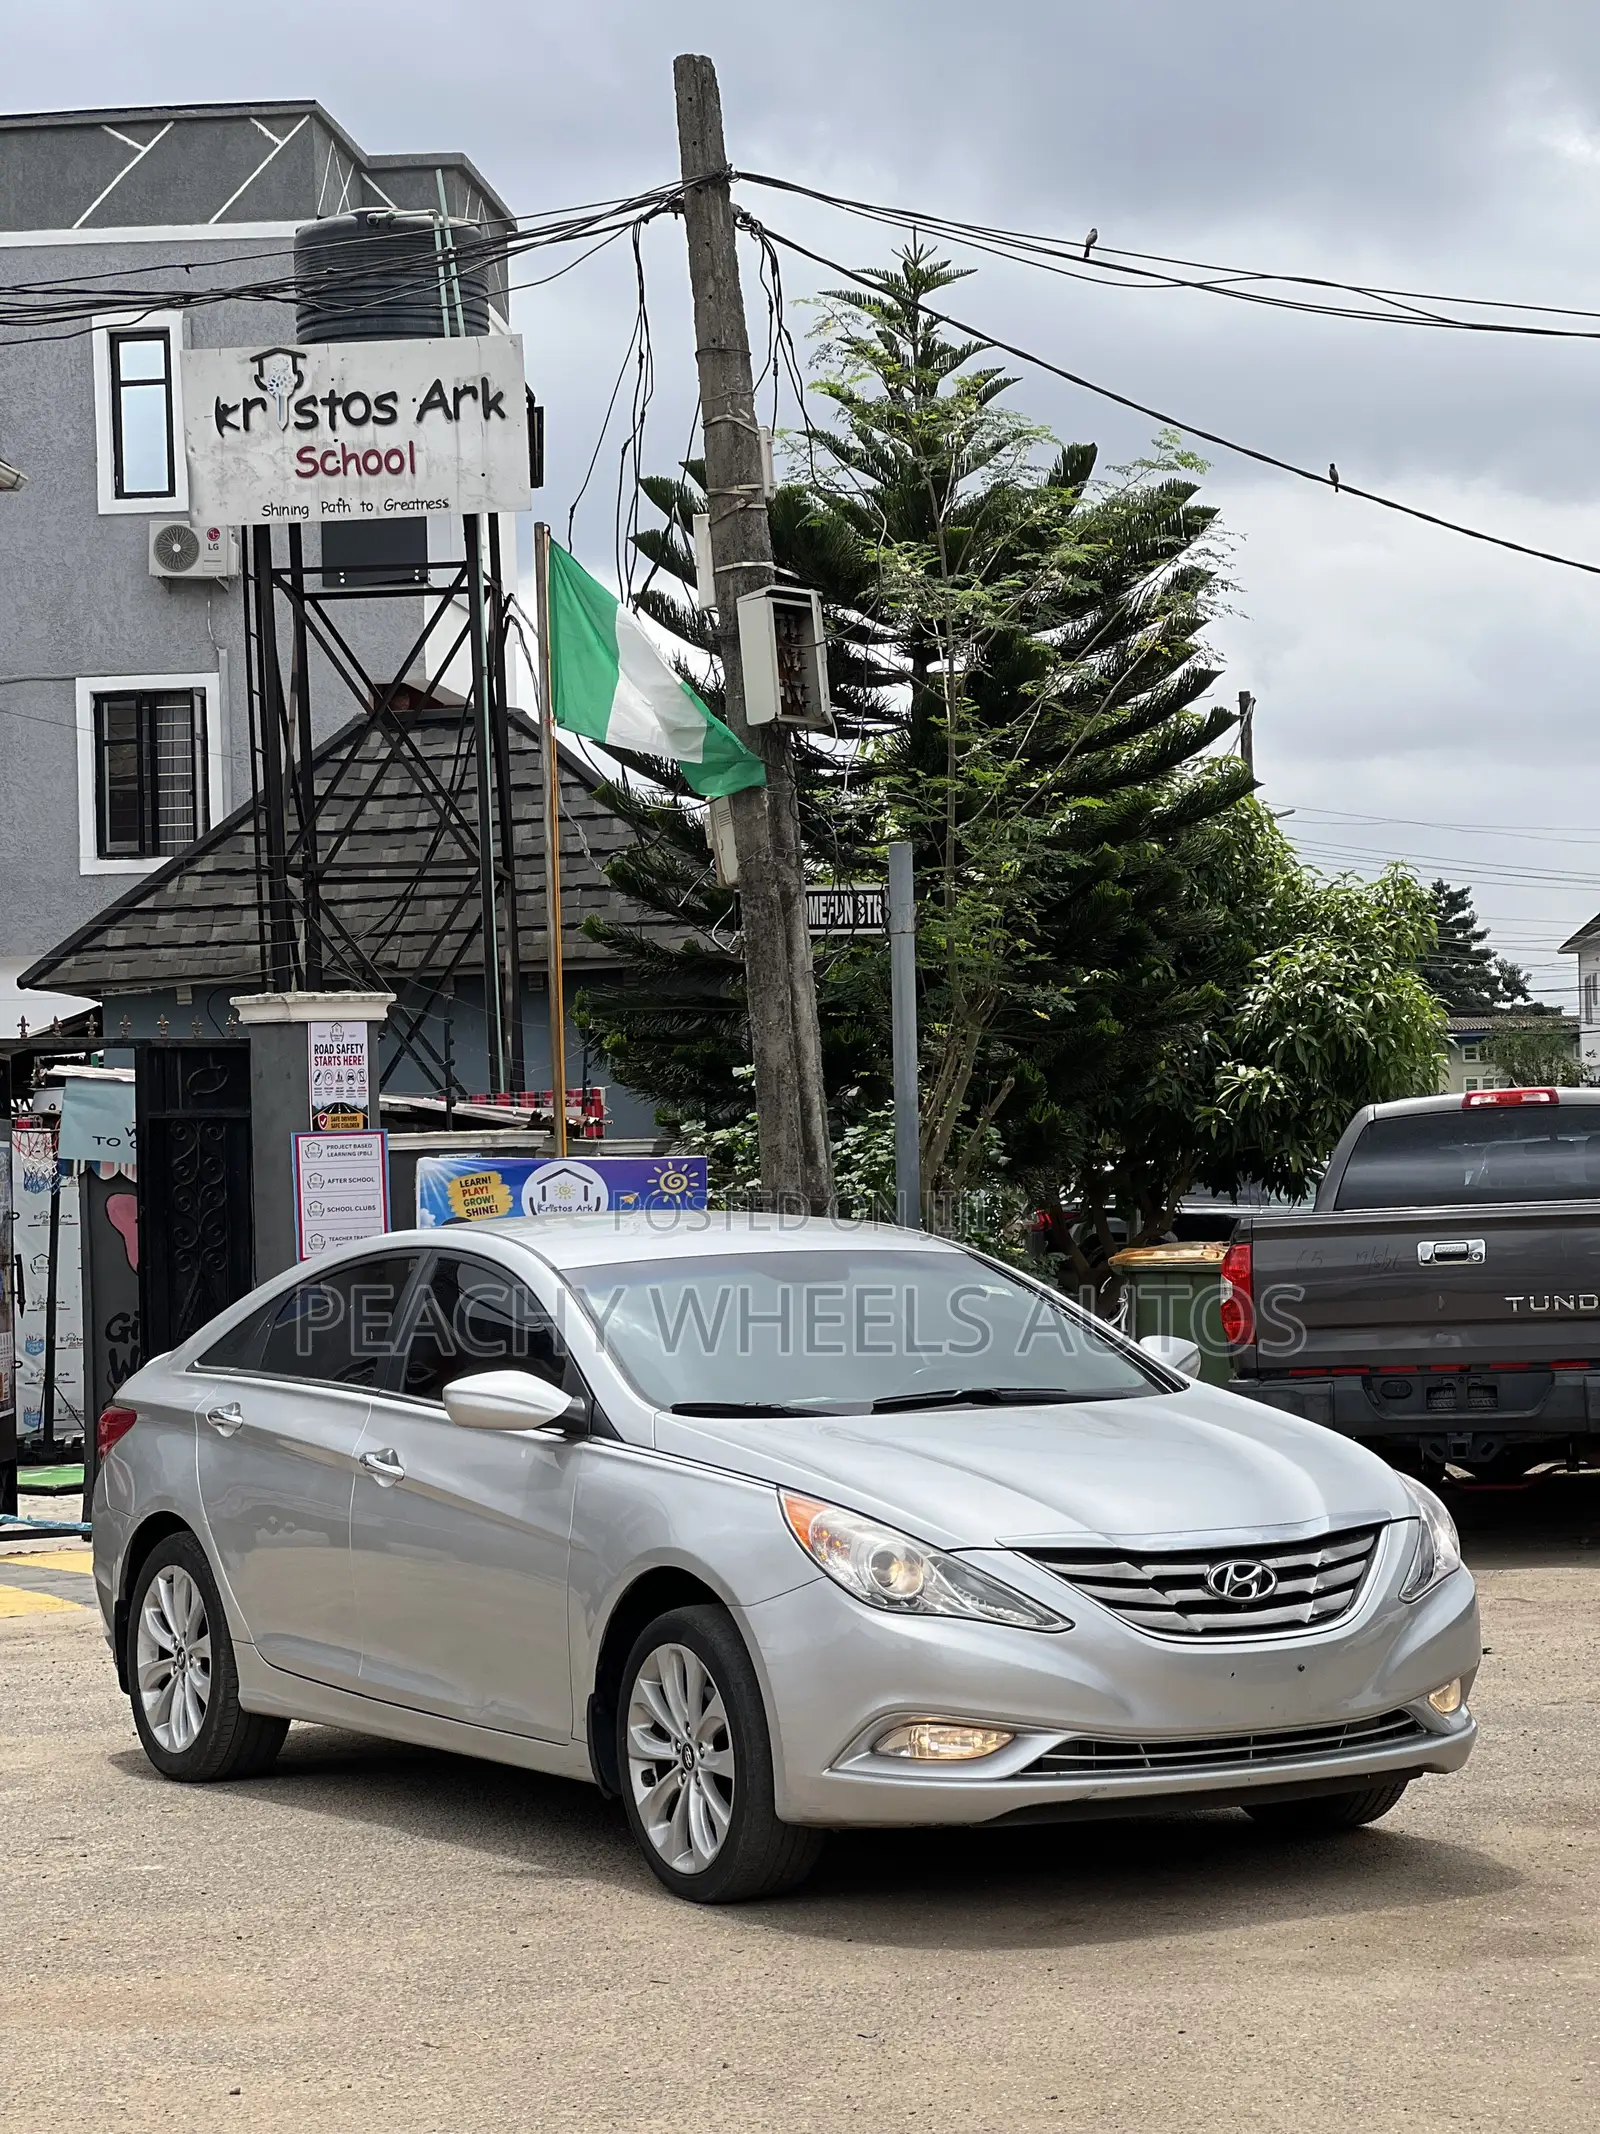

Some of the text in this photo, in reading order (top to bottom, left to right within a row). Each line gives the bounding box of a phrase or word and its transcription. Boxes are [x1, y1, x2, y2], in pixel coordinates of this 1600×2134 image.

[416, 377, 506, 423] Ark
[294, 440, 416, 479] School
[261, 498, 449, 519] Shining Path to Greatness
[208, 543, 219, 551] LG
[314, 1043, 364, 1055] ROAD SAFETY
[314, 1055, 365, 1066] STARTS HERE!
[92, 1136, 121, 1147] TO
[459, 1175, 492, 1188] LEARN!
[461, 1185, 489, 1197] PLAY!
[463, 1194, 495, 1207] GROW!
[465, 1204, 499, 1217] SHINE!
[576, 1204, 593, 1212] Ark
[1504, 1293, 1599, 1313] TUND
